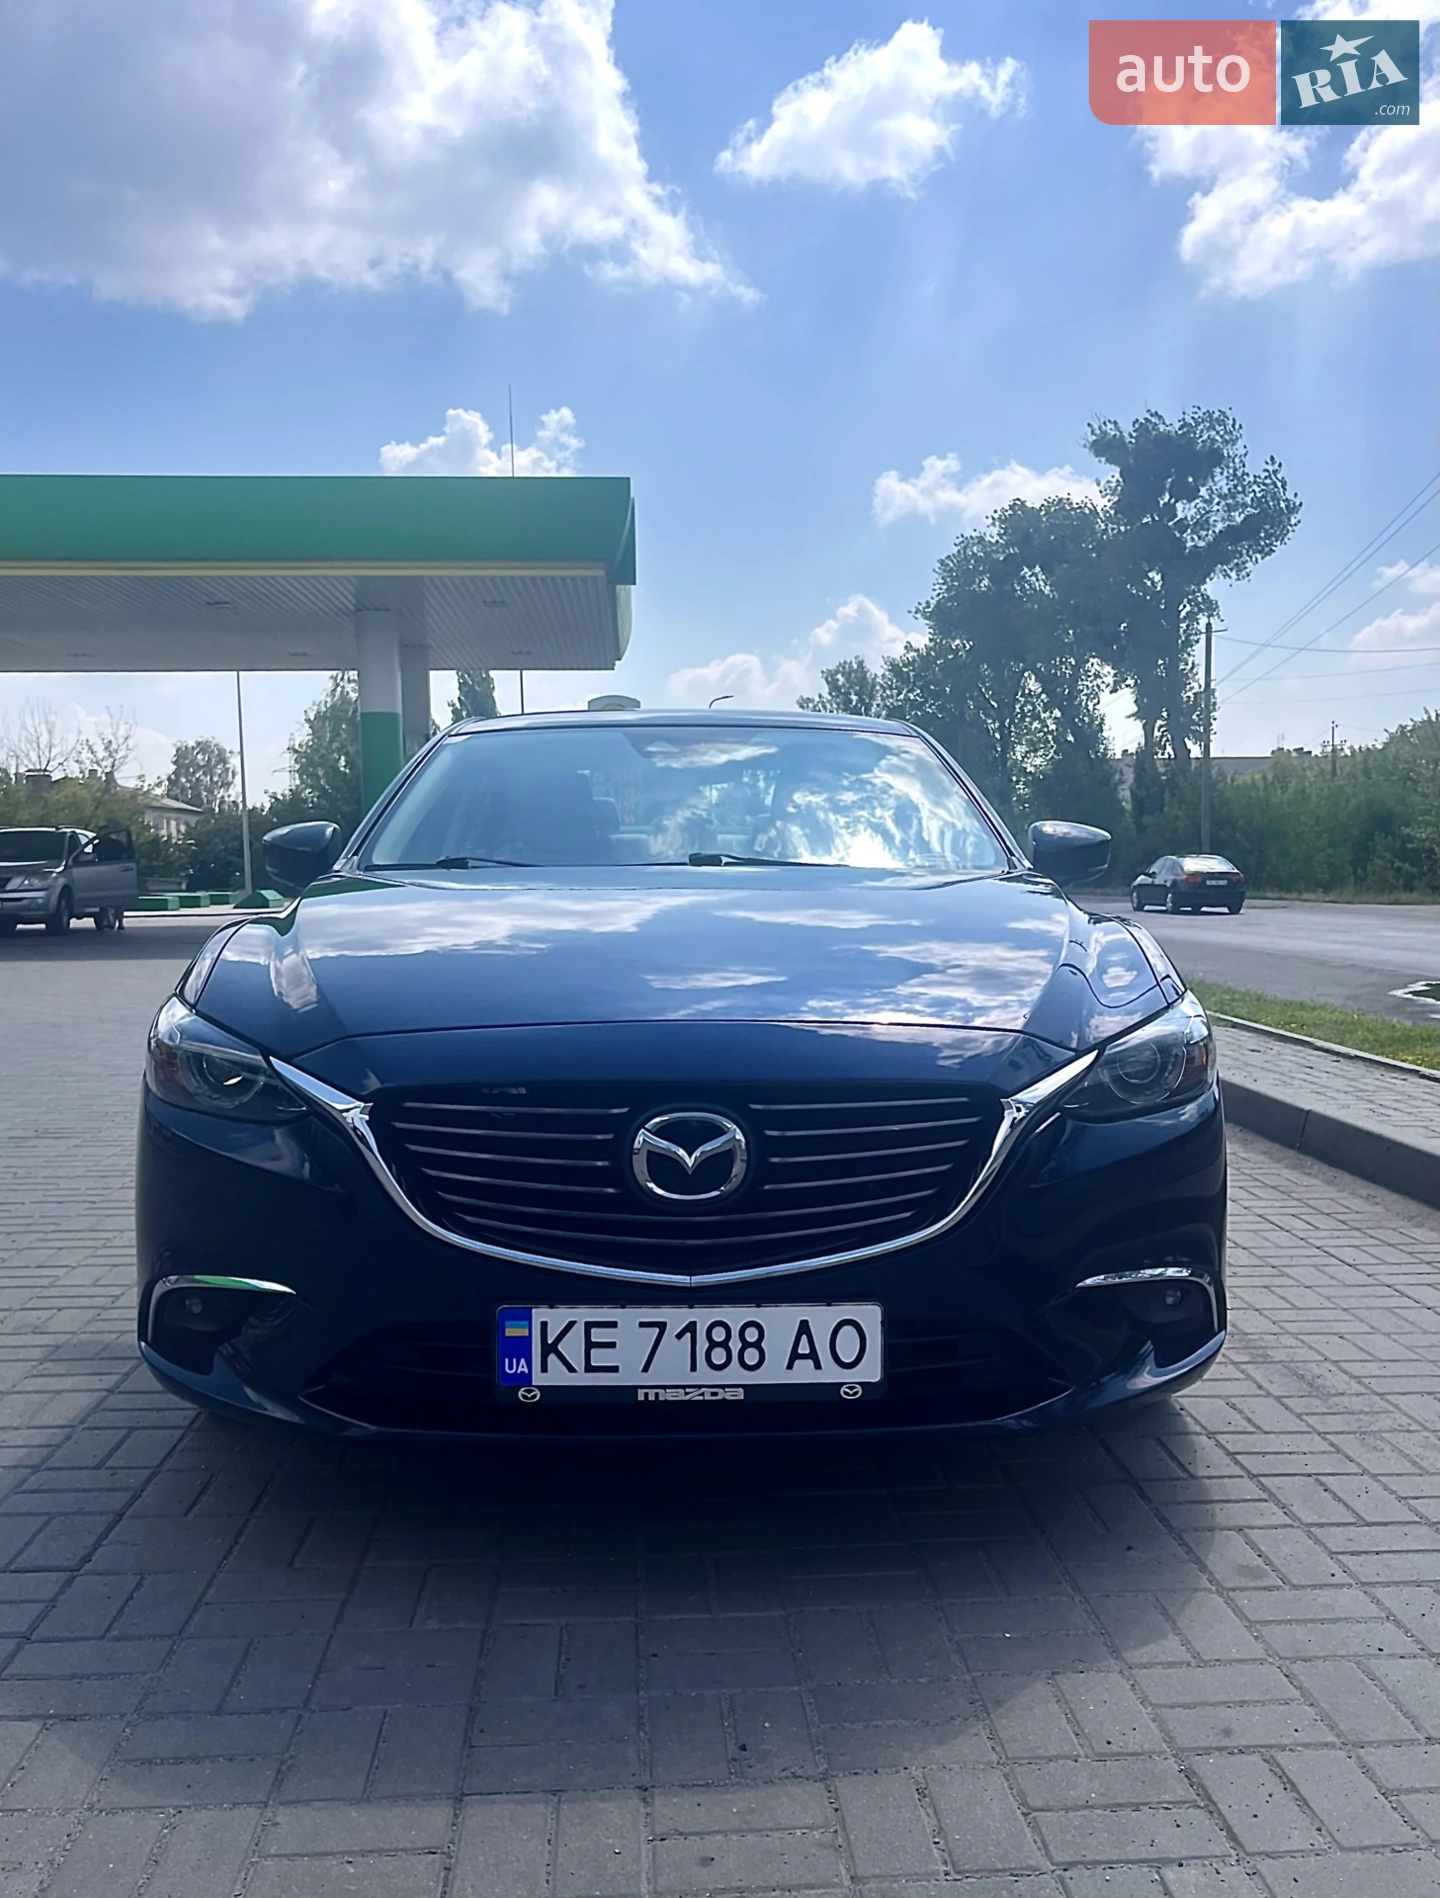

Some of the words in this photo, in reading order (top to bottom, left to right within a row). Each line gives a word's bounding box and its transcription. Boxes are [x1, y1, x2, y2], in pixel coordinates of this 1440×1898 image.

[539, 1319, 620, 1374] KE
[638, 1319, 766, 1373] 7188
[785, 1318, 868, 1371] AO
[505, 1358, 529, 1375] UA
